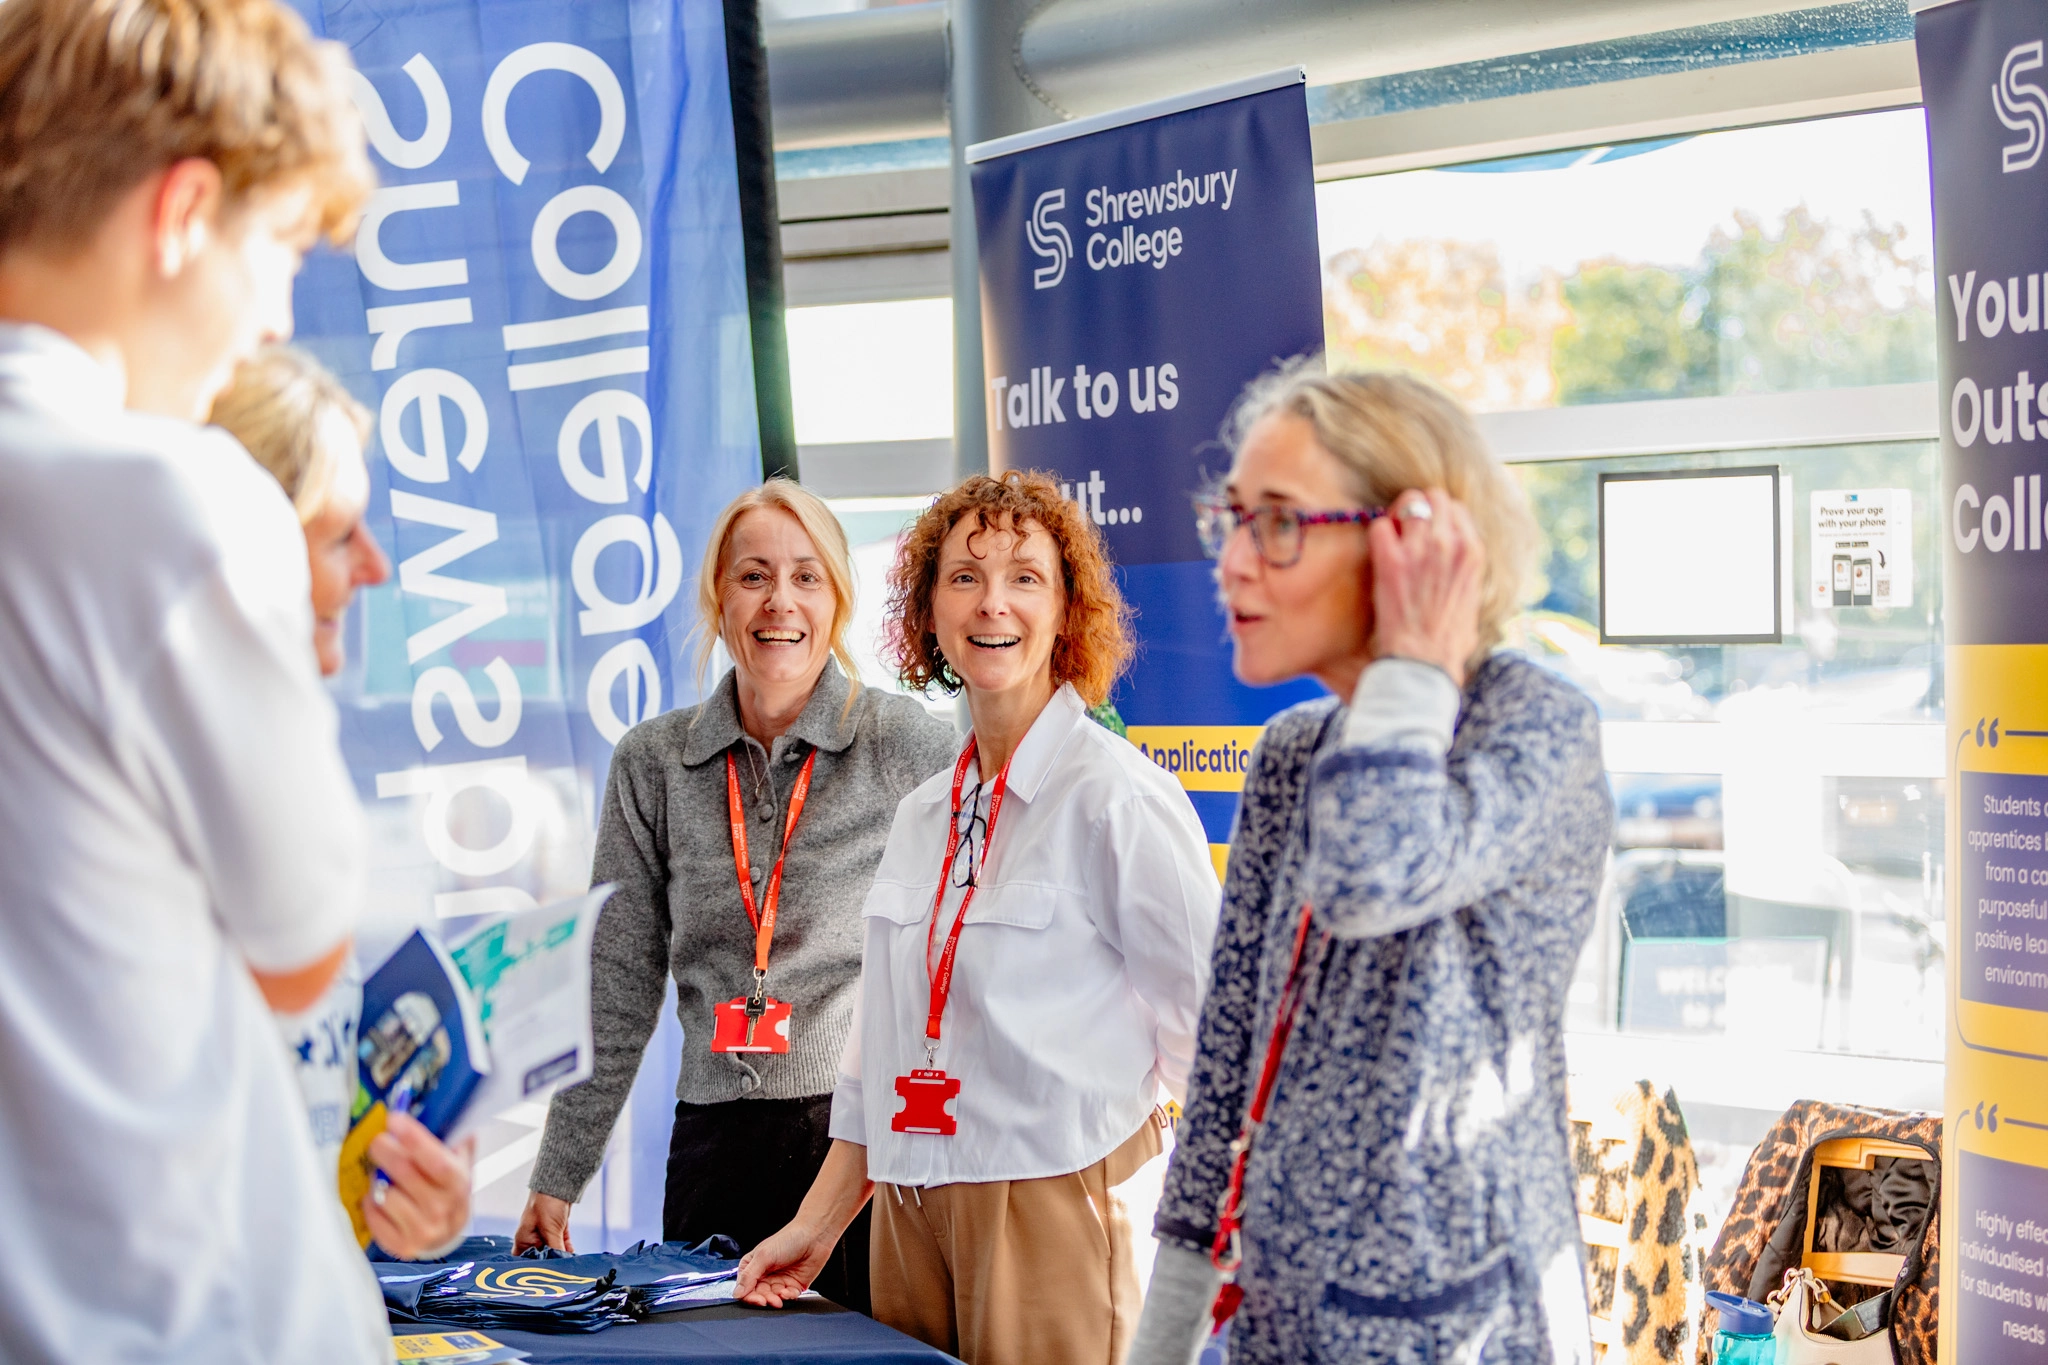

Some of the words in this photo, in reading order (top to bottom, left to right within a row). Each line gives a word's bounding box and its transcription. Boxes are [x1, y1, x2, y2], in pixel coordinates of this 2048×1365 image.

[1086, 169, 1238, 227] Shrewsbury
[1086, 225, 1183, 271] College
[1948, 270, 2048, 342] You
[991, 366, 1067, 431] Talk
[1073, 364, 1119, 420] to
[1129, 362, 1179, 414] us
[1818, 519, 1837, 528] with
[1839, 520, 1857, 529] your
[1860, 517, 1887, 529] phone
[1820, 506, 1844, 516] Prove
[1847, 507, 1865, 517] your
[1868, 506, 1884, 517] age
[1952, 474, 2048, 553] Coll
[1984, 794, 2041, 817] Students
[1968, 829, 2042, 853] apprentices
[1985, 861, 2016, 883] from
[2018, 868, 2029, 885] a
[1979, 898, 2048, 921] purposeful
[1975, 929, 2022, 953] positive
[1975, 1209, 2014, 1242] Highly
[1959, 1236, 2044, 1277] individualised
[1960, 1269, 1976, 1292] for
[1976, 1278, 2032, 1309] students
[2003, 1319, 2046, 1345] needs
